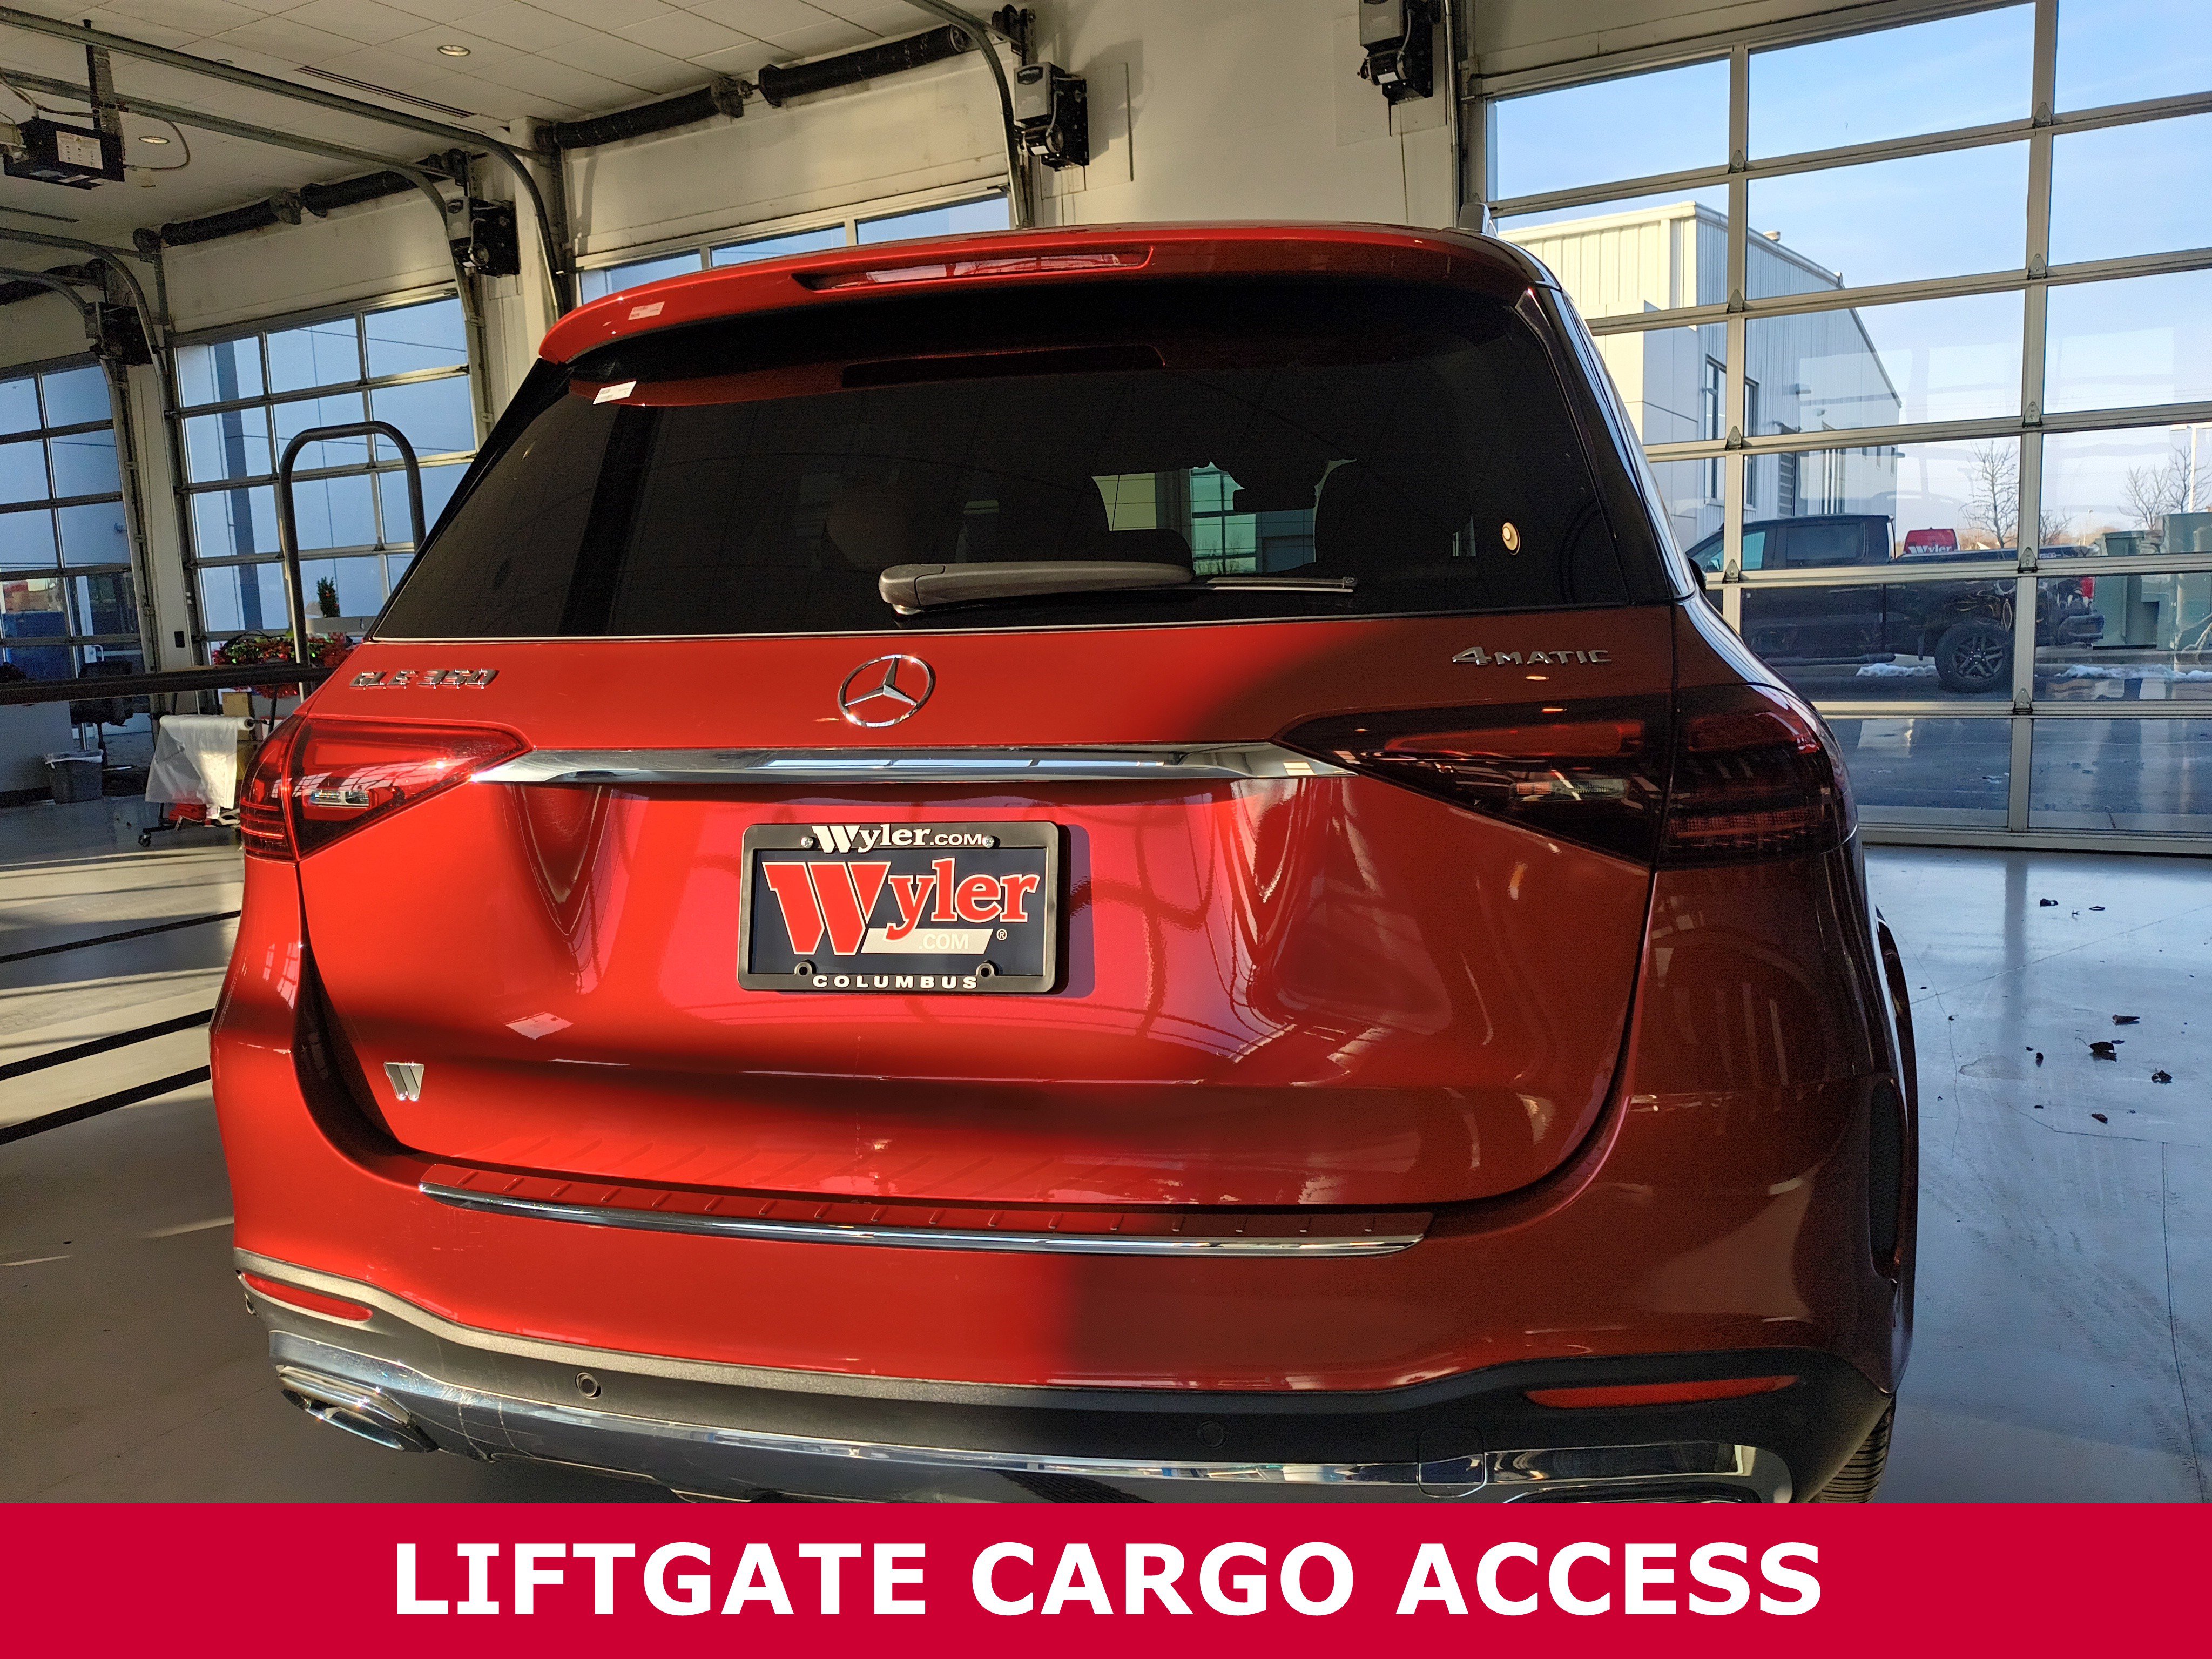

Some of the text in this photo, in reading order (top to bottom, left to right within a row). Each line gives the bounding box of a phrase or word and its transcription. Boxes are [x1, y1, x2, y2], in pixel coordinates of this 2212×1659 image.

[1908, 544, 1952, 554] Wyler
[1452, 646, 1612, 665] 4MATIC
[417, 669, 499, 686] 350
[761, 857, 1040, 956] Wyler
[812, 975, 978, 990] COLUMBUS
